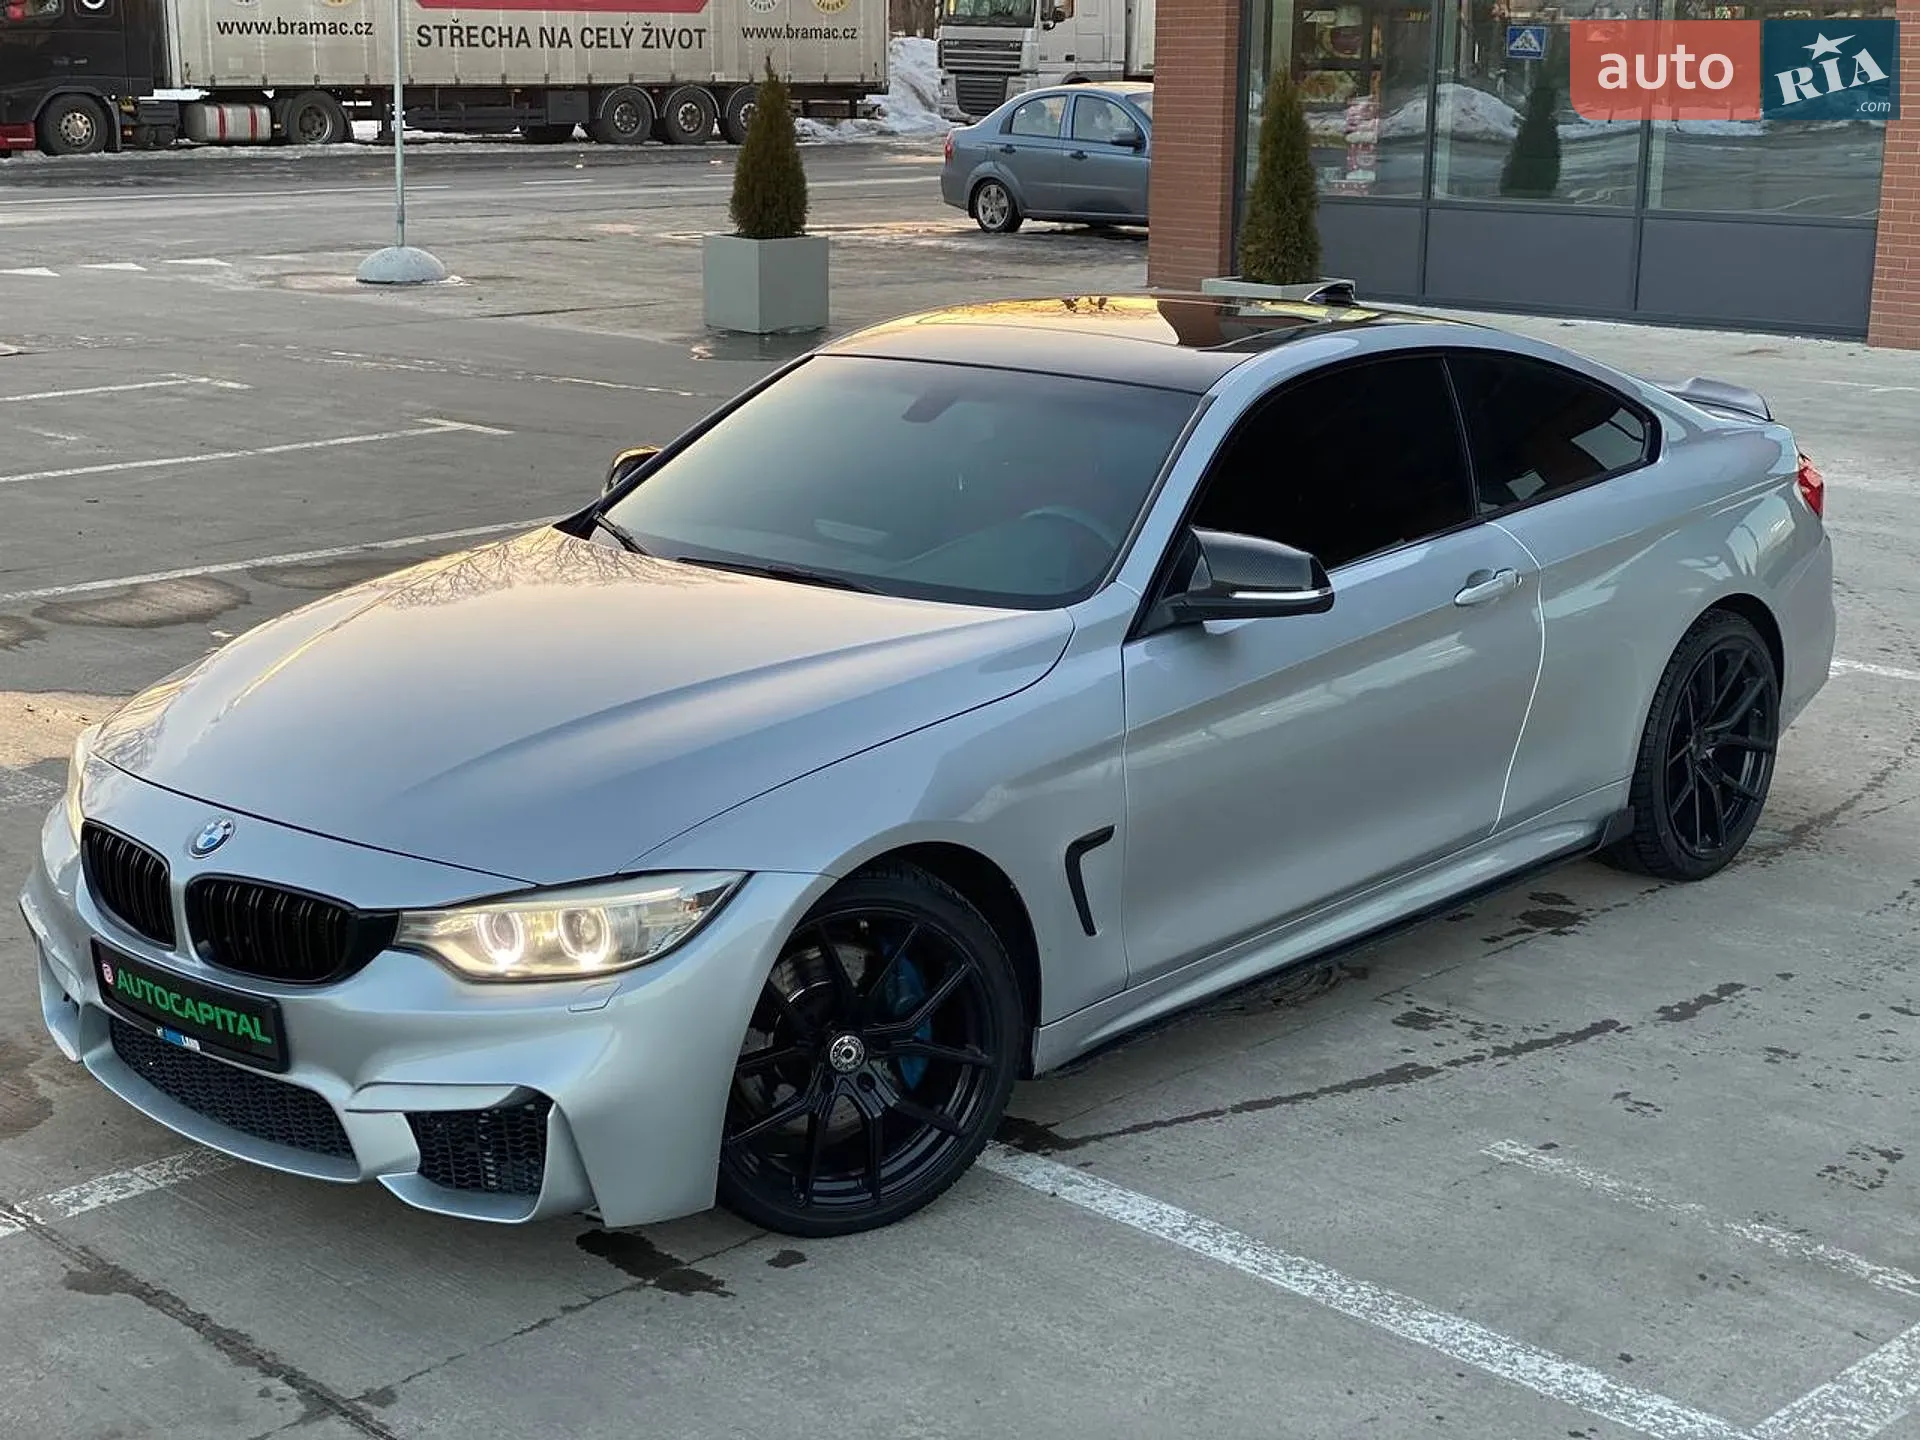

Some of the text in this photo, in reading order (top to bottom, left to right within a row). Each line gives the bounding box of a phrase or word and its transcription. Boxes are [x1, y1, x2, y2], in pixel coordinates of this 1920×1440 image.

[217, 18, 373, 35] www.bramac.cz
[417, 18, 706, 49] STŘECHA NA CELÝ ŽIVOT
[742, 24, 857, 39] www.bramac.cz
[116, 968, 272, 1044] AUTOCAPITAL
